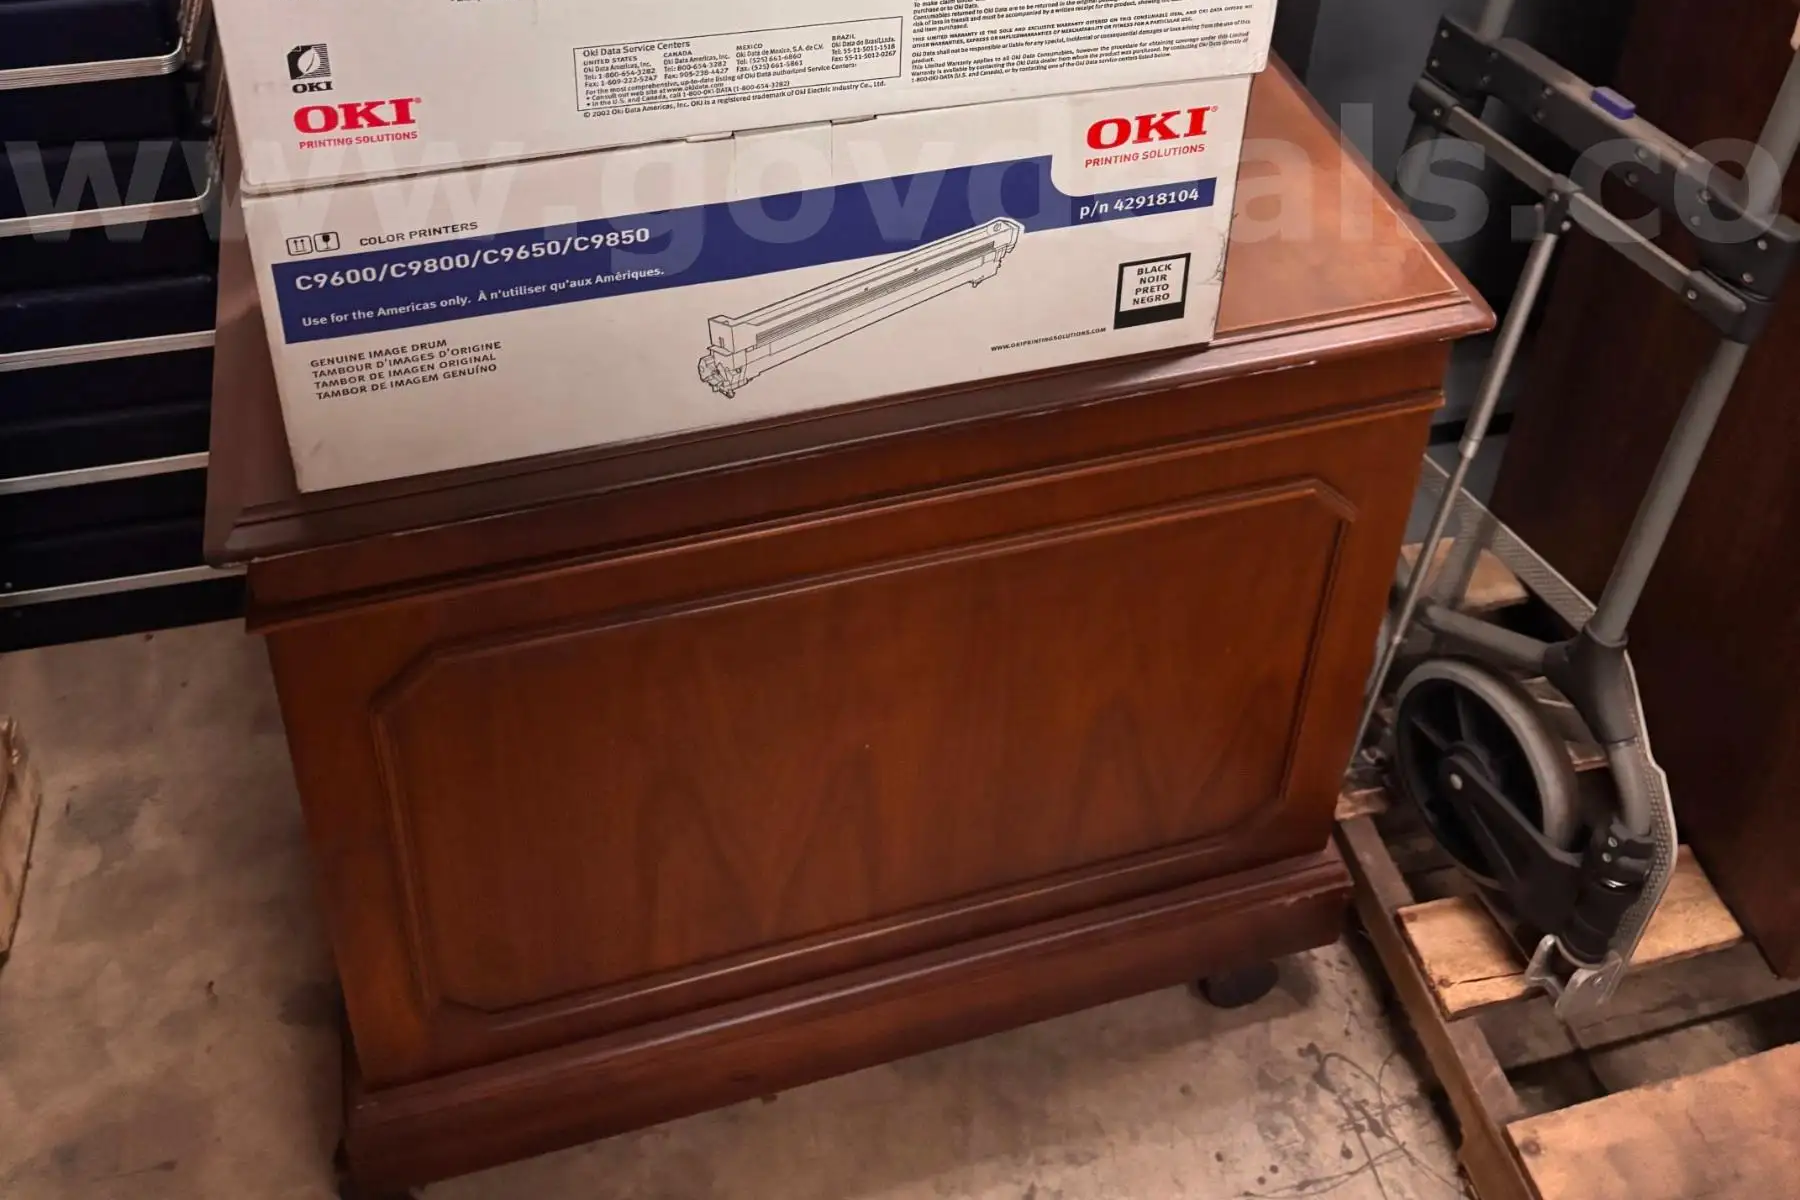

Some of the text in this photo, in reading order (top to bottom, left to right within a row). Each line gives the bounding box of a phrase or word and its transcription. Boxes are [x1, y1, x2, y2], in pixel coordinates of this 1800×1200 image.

[582, 41, 691, 58] Oki Data Service Centers
[292, 81, 333, 94] OKI
[293, 98, 416, 134] OKI
[1085, 106, 1210, 150] OKI
[299, 131, 418, 150] PRINTING SOLUTIONS
[1085, 143, 1205, 169] PRINTING SOLUTIONS
[1080, 188, 1199, 220] p/n 42918104
[359, 221, 478, 246] COLOR PRINTERS
[295, 227, 650, 291] C9600/C9800/C9650/C9850
[1136, 263, 1172, 276] BLACK
[1135, 283, 1170, 295] PRETO
[1139, 274, 1168, 285] NOIR
[302, 317, 328, 327] Use
[330, 313, 349, 323] for
[352, 310, 374, 320] the
[377, 301, 437, 317] Americas
[439, 295, 471, 307] only.
[490, 284, 547, 300] n'utiliser
[549, 278, 593, 293] qu'aux
[595, 268, 665, 284] Amériques.
[1132, 293, 1170, 306] NEGRO
[310, 339, 447, 368] GENUINE IMAGE DRUM
[312, 341, 502, 378] TAMBOUR D'IMAGES D'ORIGINE
[314, 353, 496, 389] TAMBOR DE IMAGEN ORIGINAL
[315, 385, 367, 400] TAMBOR
[371, 381, 388, 392] DE
[390, 373, 439, 388] IMAGEM
